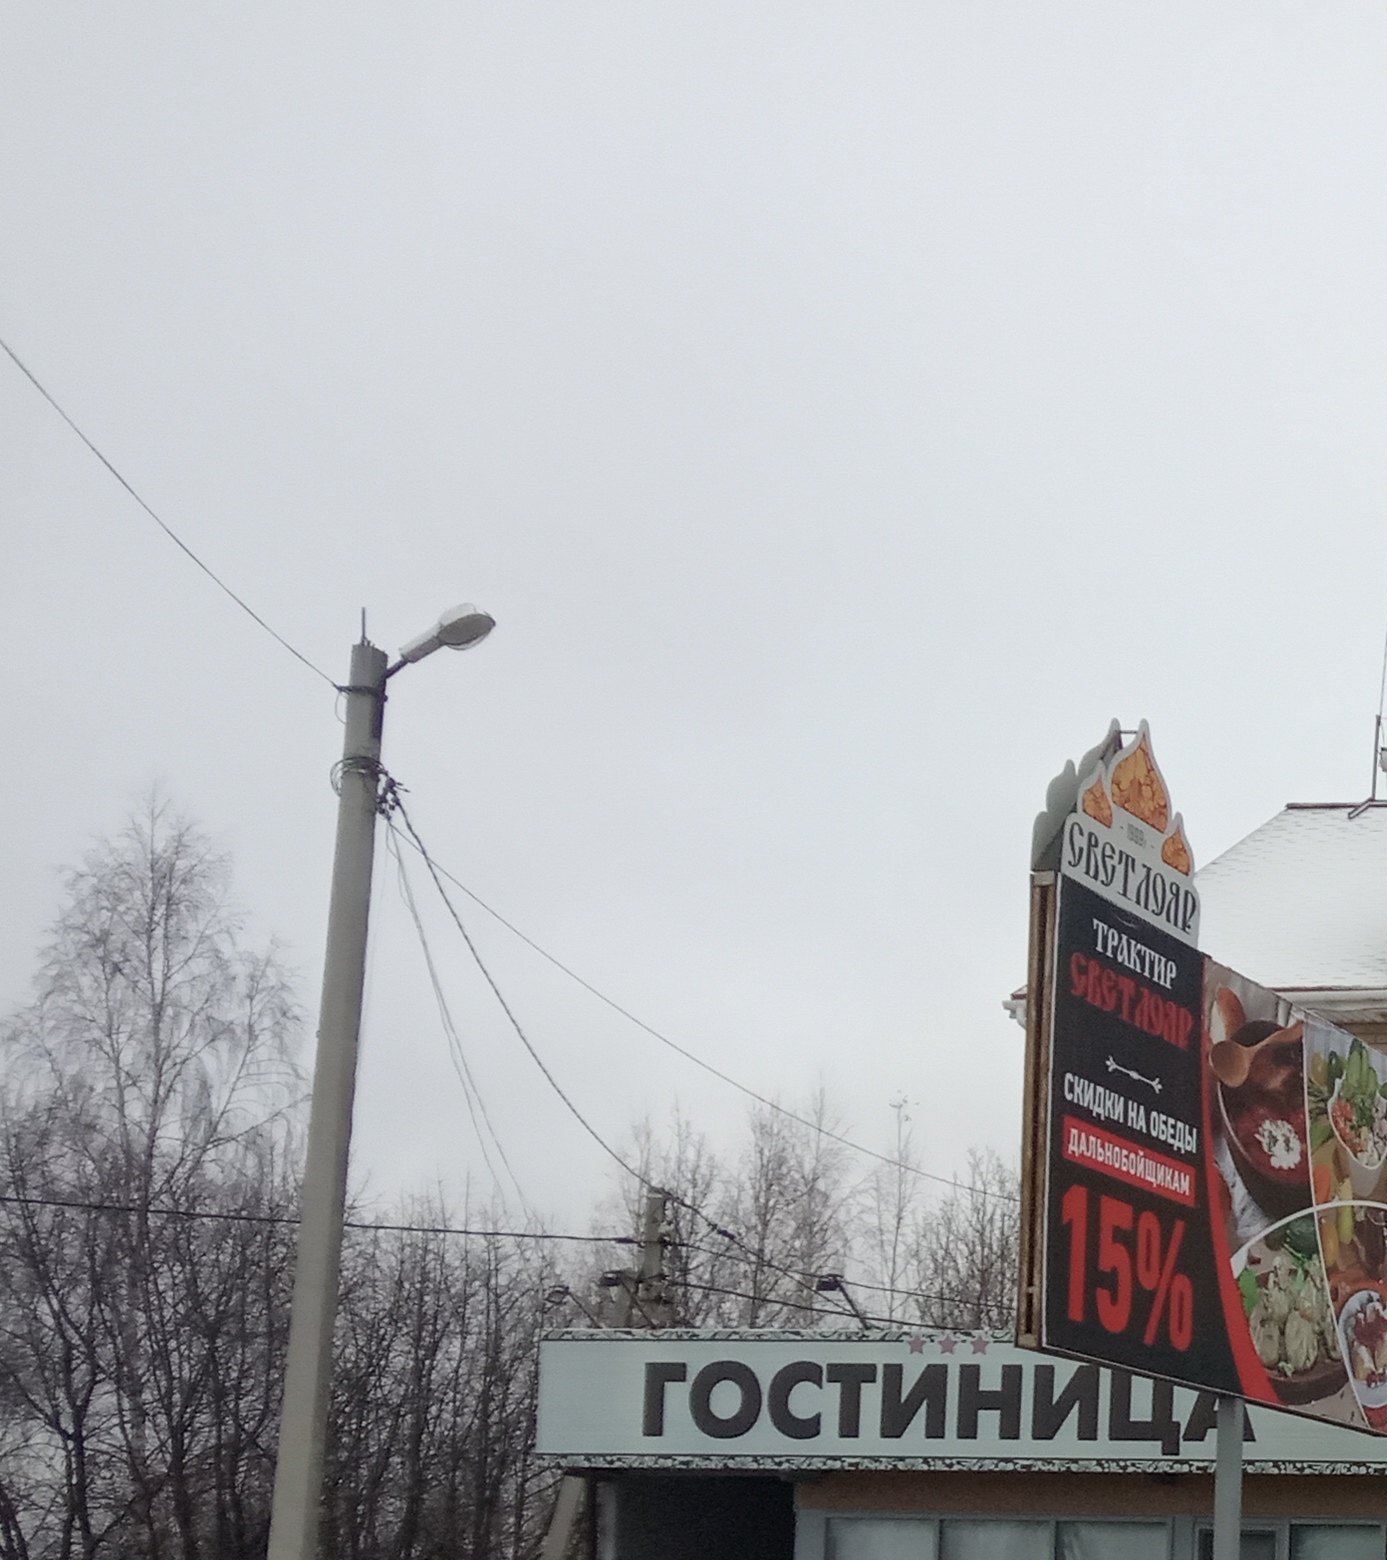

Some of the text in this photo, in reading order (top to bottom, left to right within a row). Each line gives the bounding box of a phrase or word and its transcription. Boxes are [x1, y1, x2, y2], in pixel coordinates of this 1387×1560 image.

[1067, 821, 1197, 935] СВЕТЛОЯР
[1092, 917, 1178, 990] ТРАКТИР
[1070, 952, 1195, 1050] СВЕТЛОЯР
[1064, 1072, 1197, 1154] СКИДКИ НА ОБЕДЫ
[1067, 1128, 1191, 1196] ДАЛЬНОБОЙЩИКАМ
[1061, 1183, 1193, 1352] 15%
